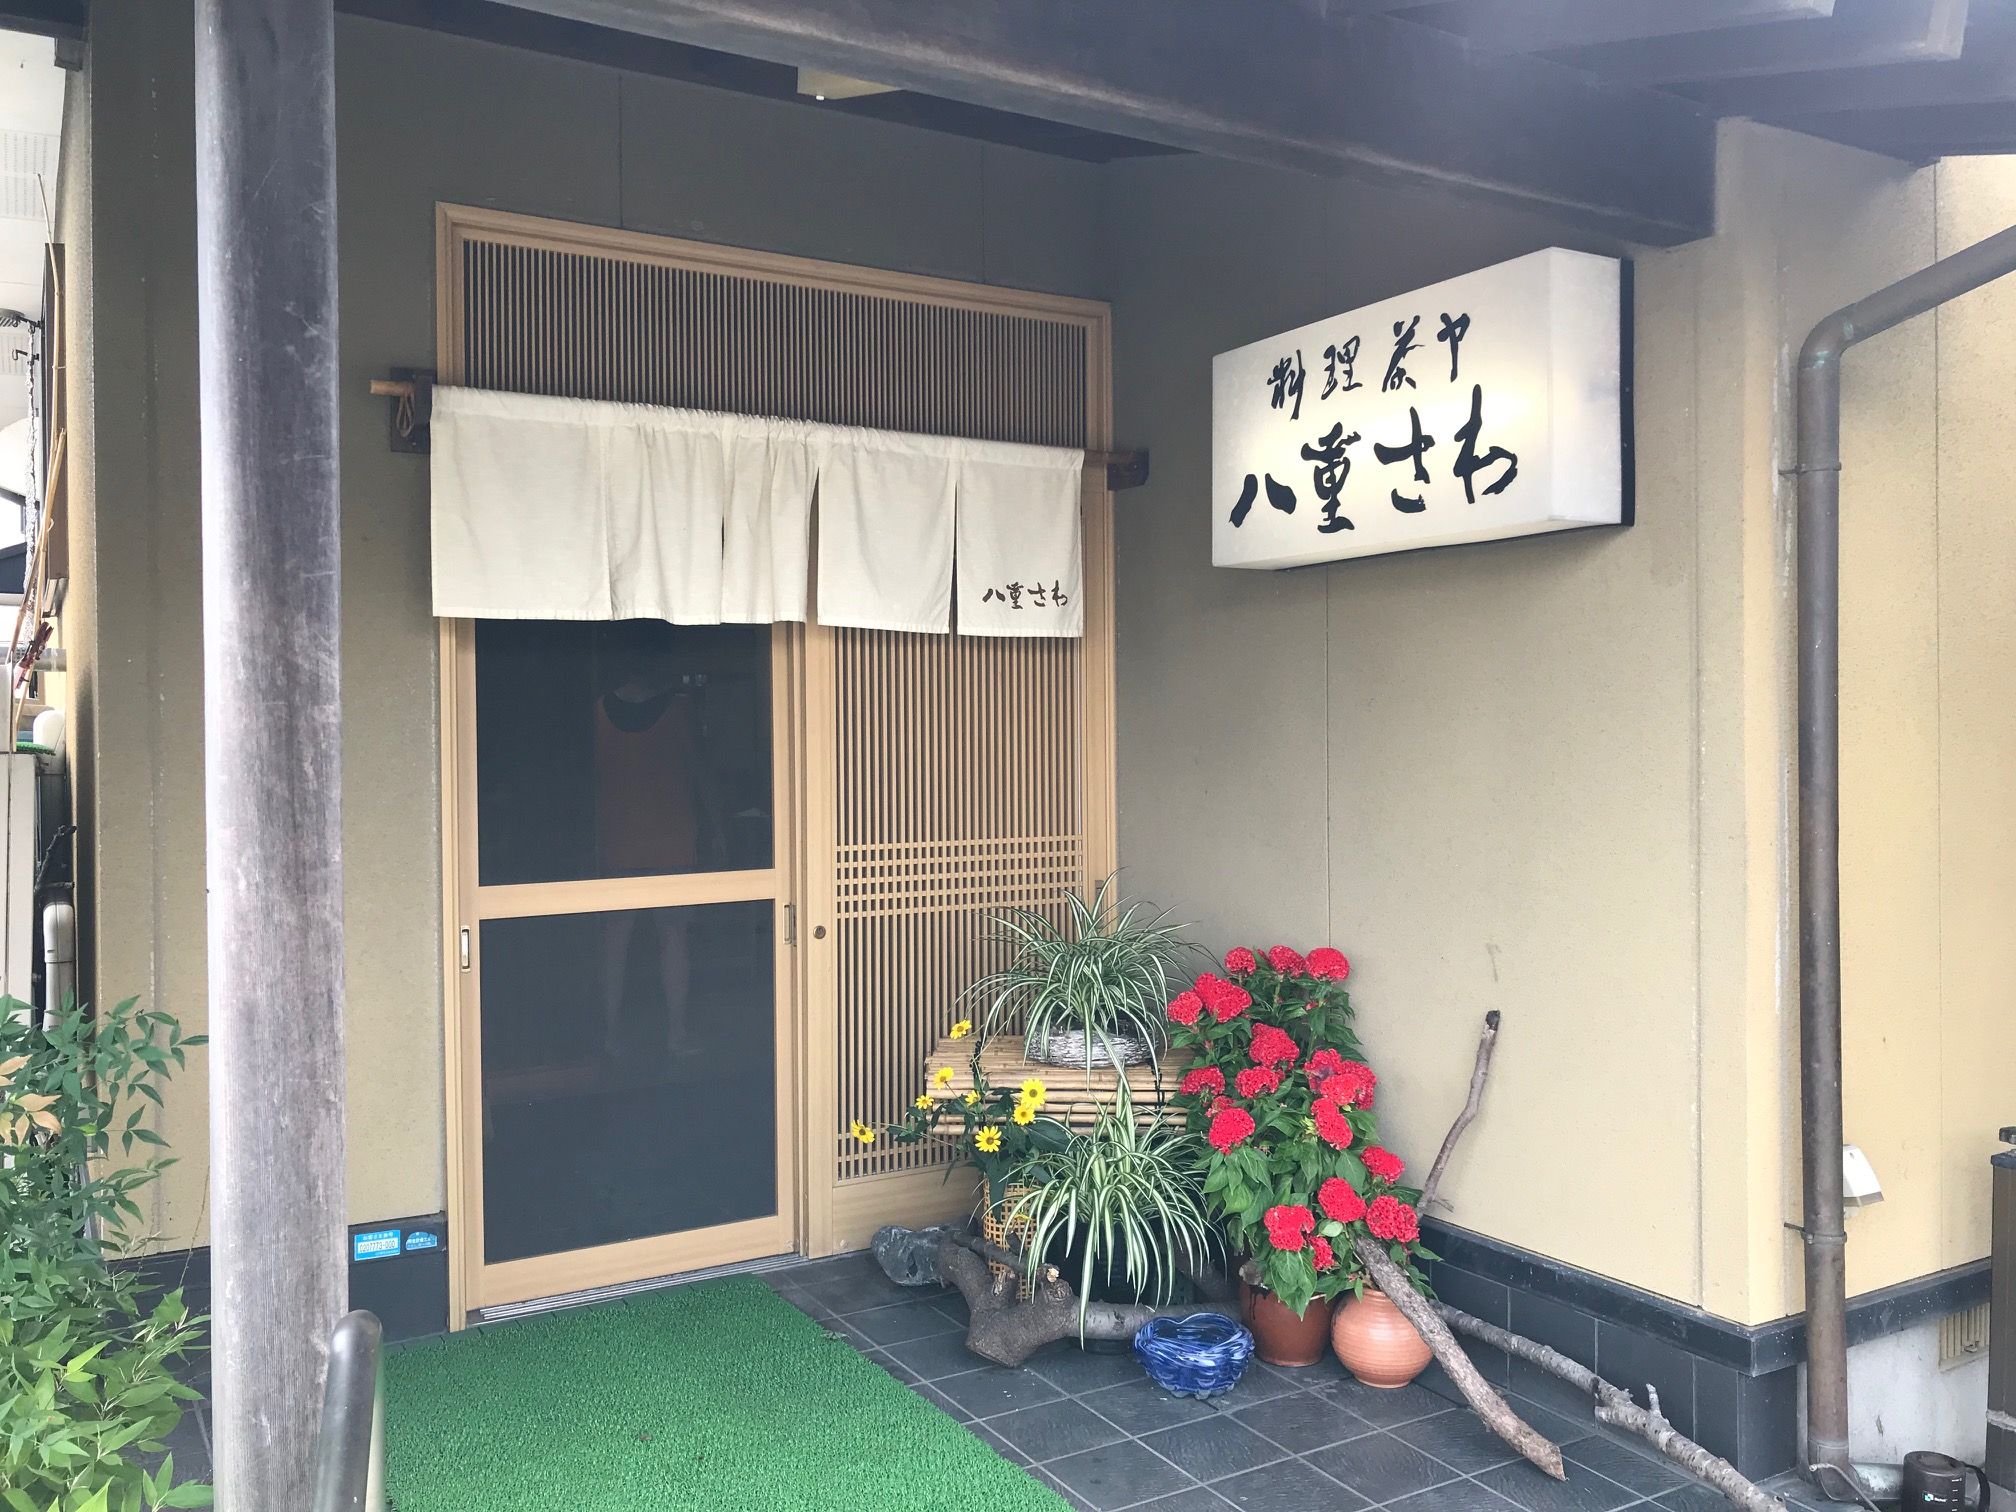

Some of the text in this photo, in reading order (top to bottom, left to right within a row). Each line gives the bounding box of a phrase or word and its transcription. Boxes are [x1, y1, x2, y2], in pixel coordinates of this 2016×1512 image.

[1229, 384, 1518, 533] 八重さわ
[982, 580, 1068, 609] 八重さわ
